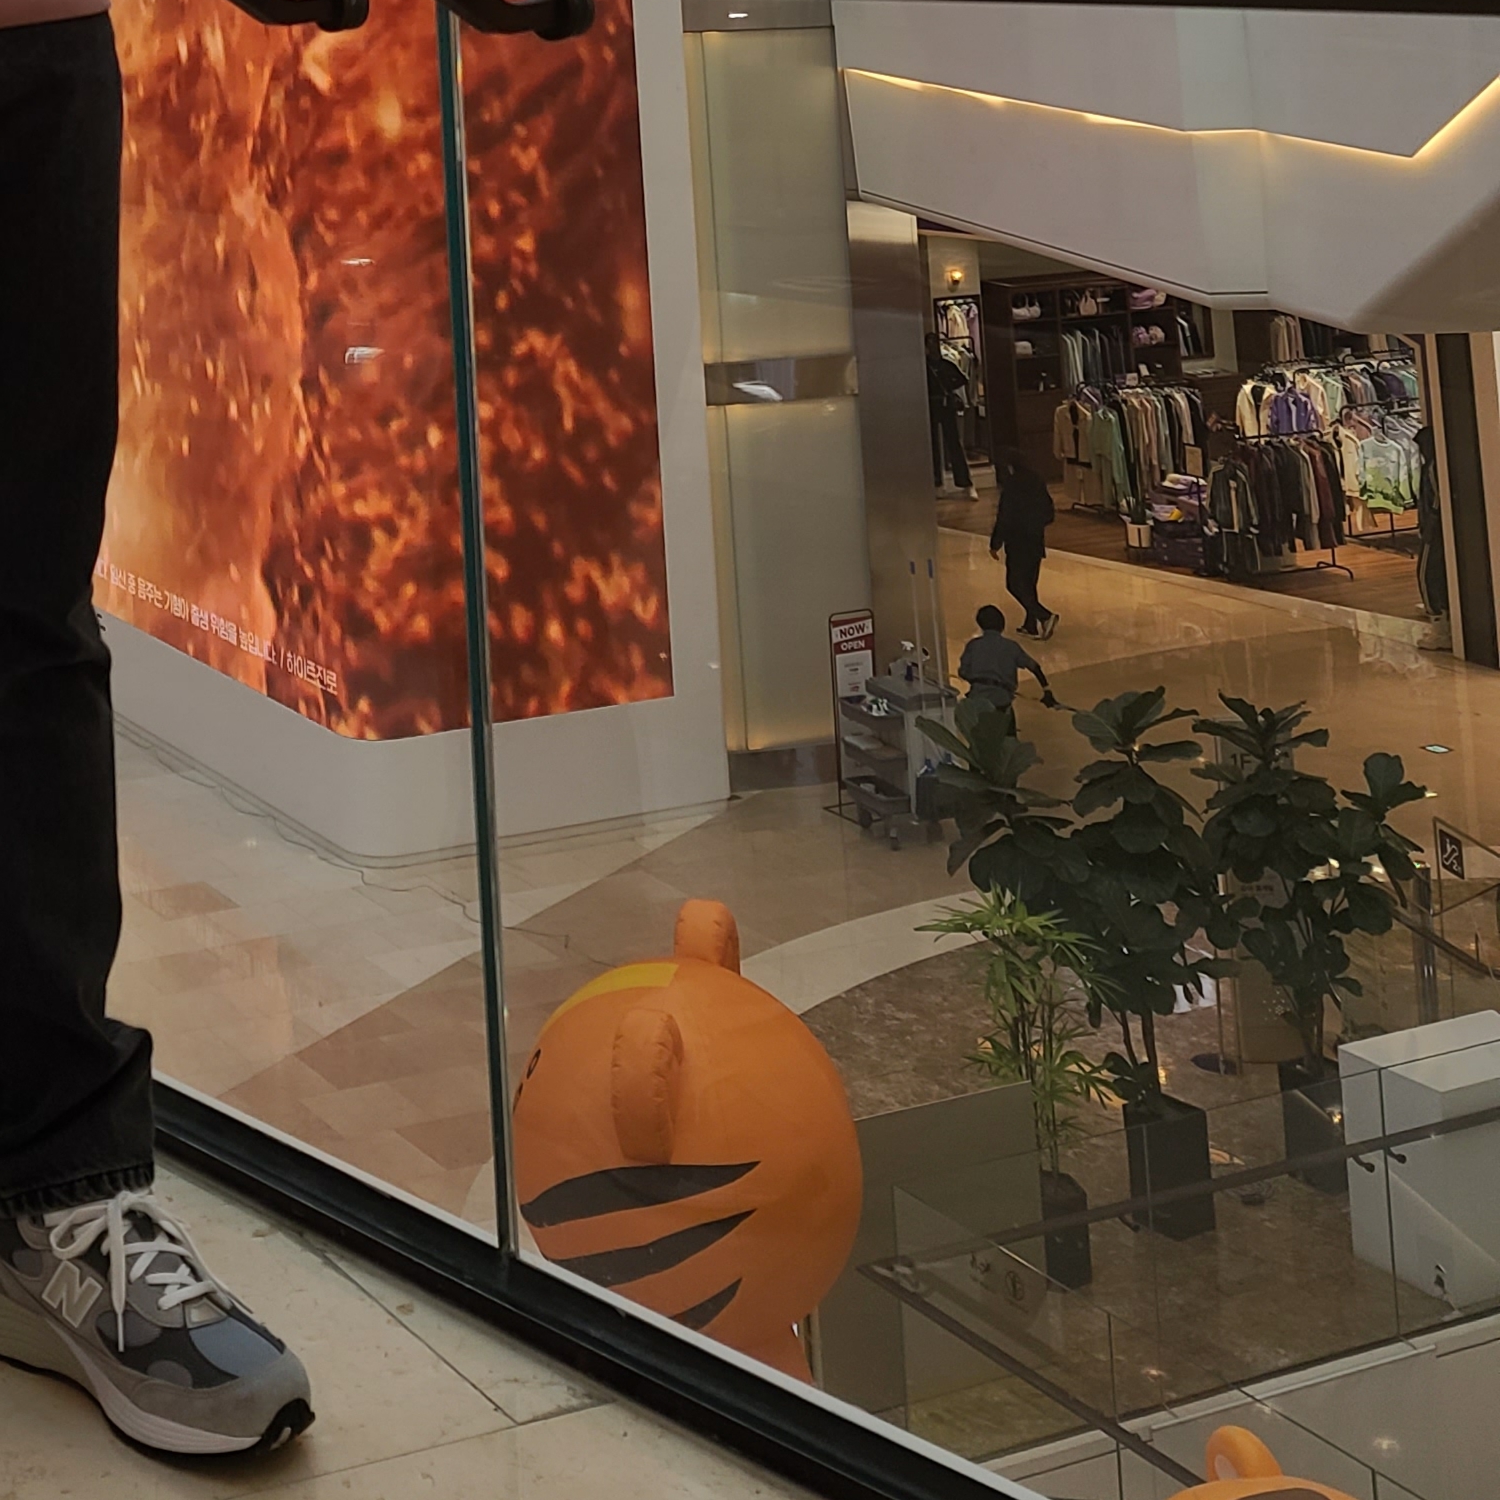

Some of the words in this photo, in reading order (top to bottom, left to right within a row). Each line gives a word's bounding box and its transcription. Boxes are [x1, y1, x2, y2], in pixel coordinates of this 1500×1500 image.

[127, 572, 136, 595] 중
[137, 576, 163, 609] 음주는
[210, 613, 237, 647] 위험을
[286, 652, 338, 695] 하이트진로
[839, 622, 866, 639] NOW
[840, 639, 866, 651] OPEN
[42, 1260, 103, 1328] N
